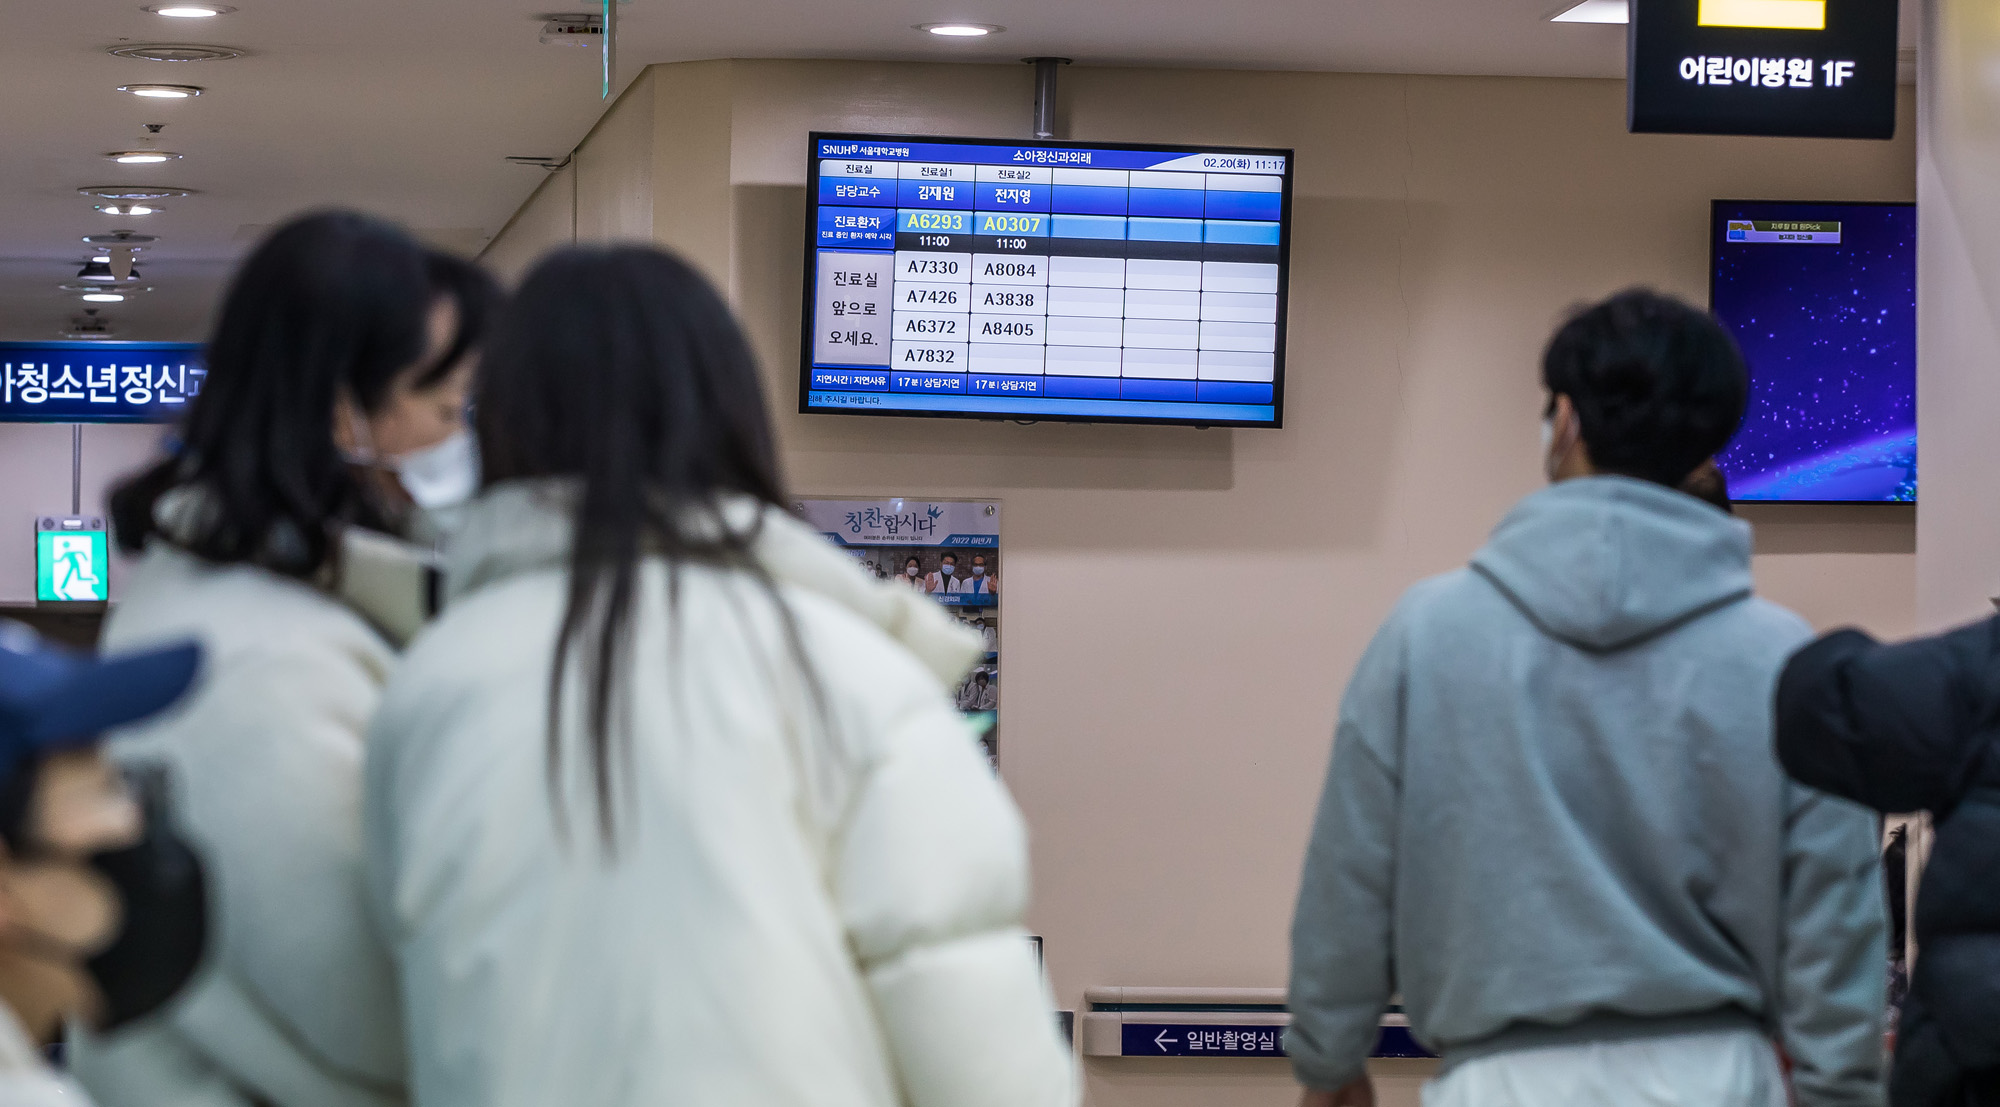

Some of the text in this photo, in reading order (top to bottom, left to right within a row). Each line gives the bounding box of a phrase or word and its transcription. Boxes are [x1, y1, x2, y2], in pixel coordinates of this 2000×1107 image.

[1680, 55, 1855, 87] 어린이병원 1F
[822, 145, 851, 155] SNUH
[860, 146, 910, 157] 서울대학교병원
[1013, 150, 1092, 165] 소아정신과외래
[845, 164, 873, 175] 진료실
[920, 167, 953, 177] 진료실1
[1203, 158, 1285, 171] 02.20(화) 11:17
[998, 169, 1031, 180] 진료실2
[835, 185, 881, 199] 담당교수
[918, 186, 955, 202] 김재원
[995, 188, 1031, 205] 전지영
[834, 215, 880, 229] 진료환자
[907, 213, 963, 230] A6293
[983, 216, 1040, 233] A0307
[919, 235, 950, 247] 11:00
[996, 238, 1027, 249] 11:00
[907, 260, 959, 275] A7330
[984, 262, 1037, 277] A8084
[833, 271, 878, 288] 진료실
[906, 290, 958, 304] A7426
[984, 292, 1034, 307] A3838
[832, 300, 877, 316] 앞으로
[906, 319, 956, 334] A6372
[981, 322, 1034, 336] A8405
[828, 331, 878, 346] 오세요.
[905, 349, 955, 364] A7832
[845, 507, 936, 536] 칭찬합시다
[951, 536, 970, 544] 2022
[1187, 1030, 1274, 1051] 일반촬영실
